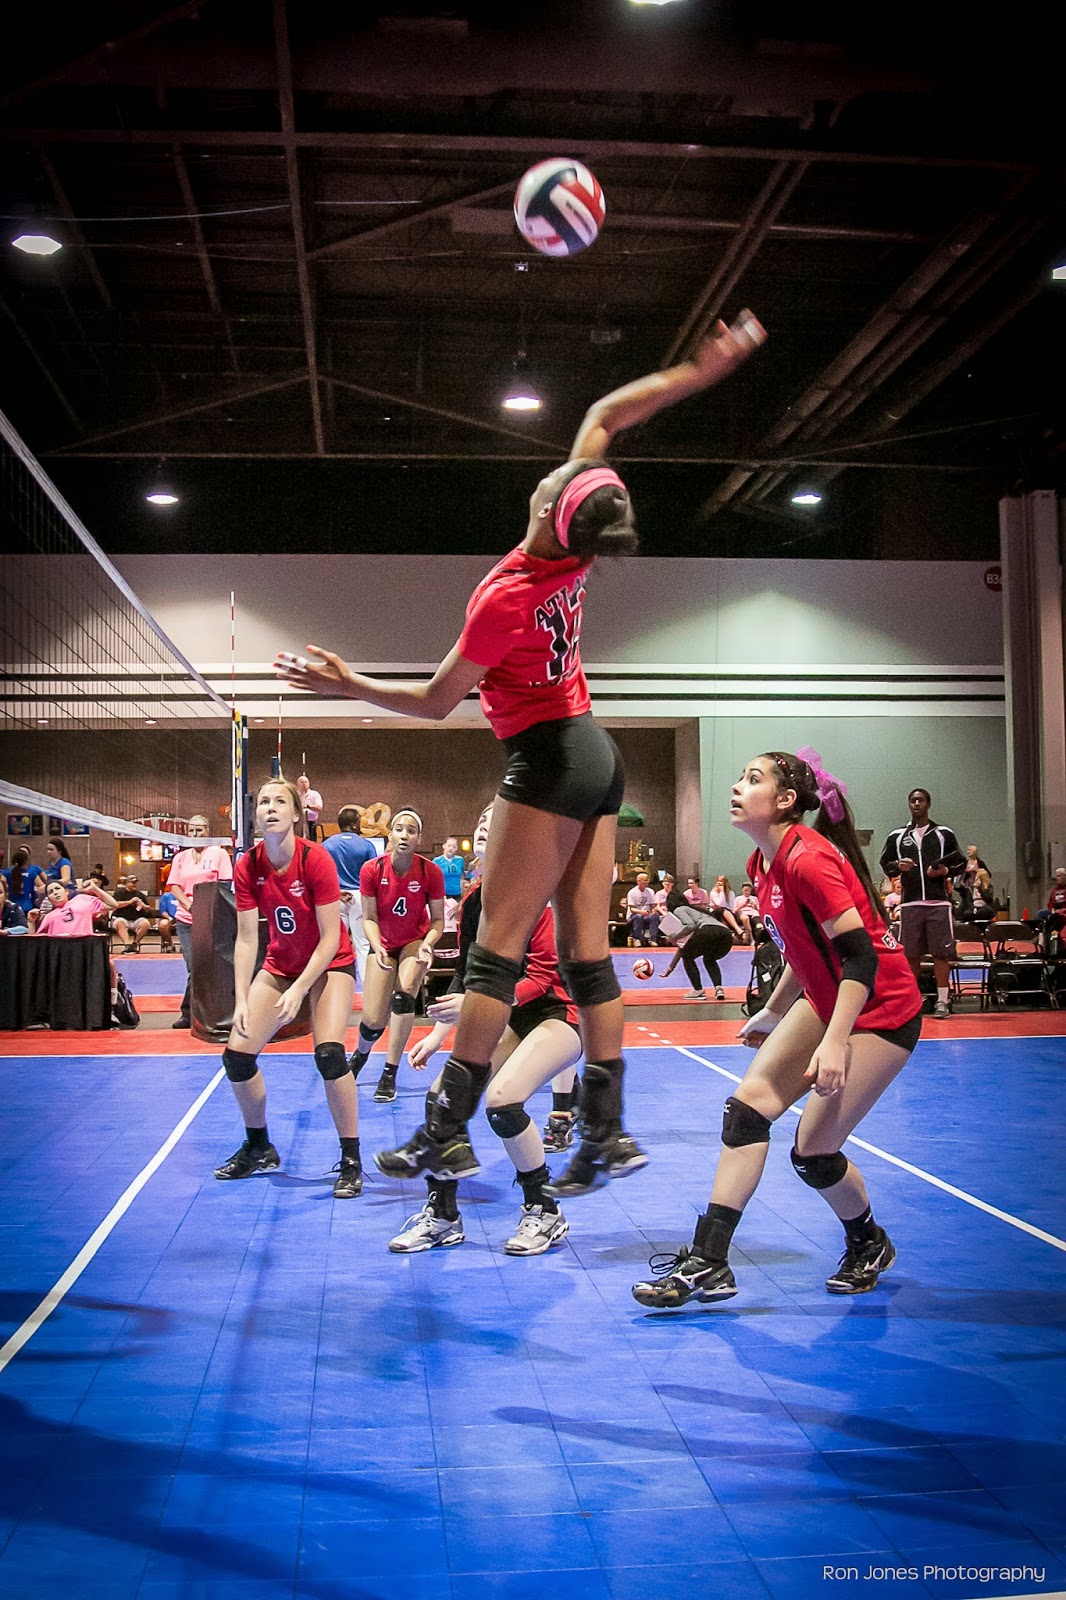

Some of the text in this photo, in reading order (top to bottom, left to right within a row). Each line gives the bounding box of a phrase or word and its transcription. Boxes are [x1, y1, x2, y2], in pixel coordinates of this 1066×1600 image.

[447, 865, 457, 874] 10
[392, 897, 407, 917] 4
[274, 905, 297, 935] 6
